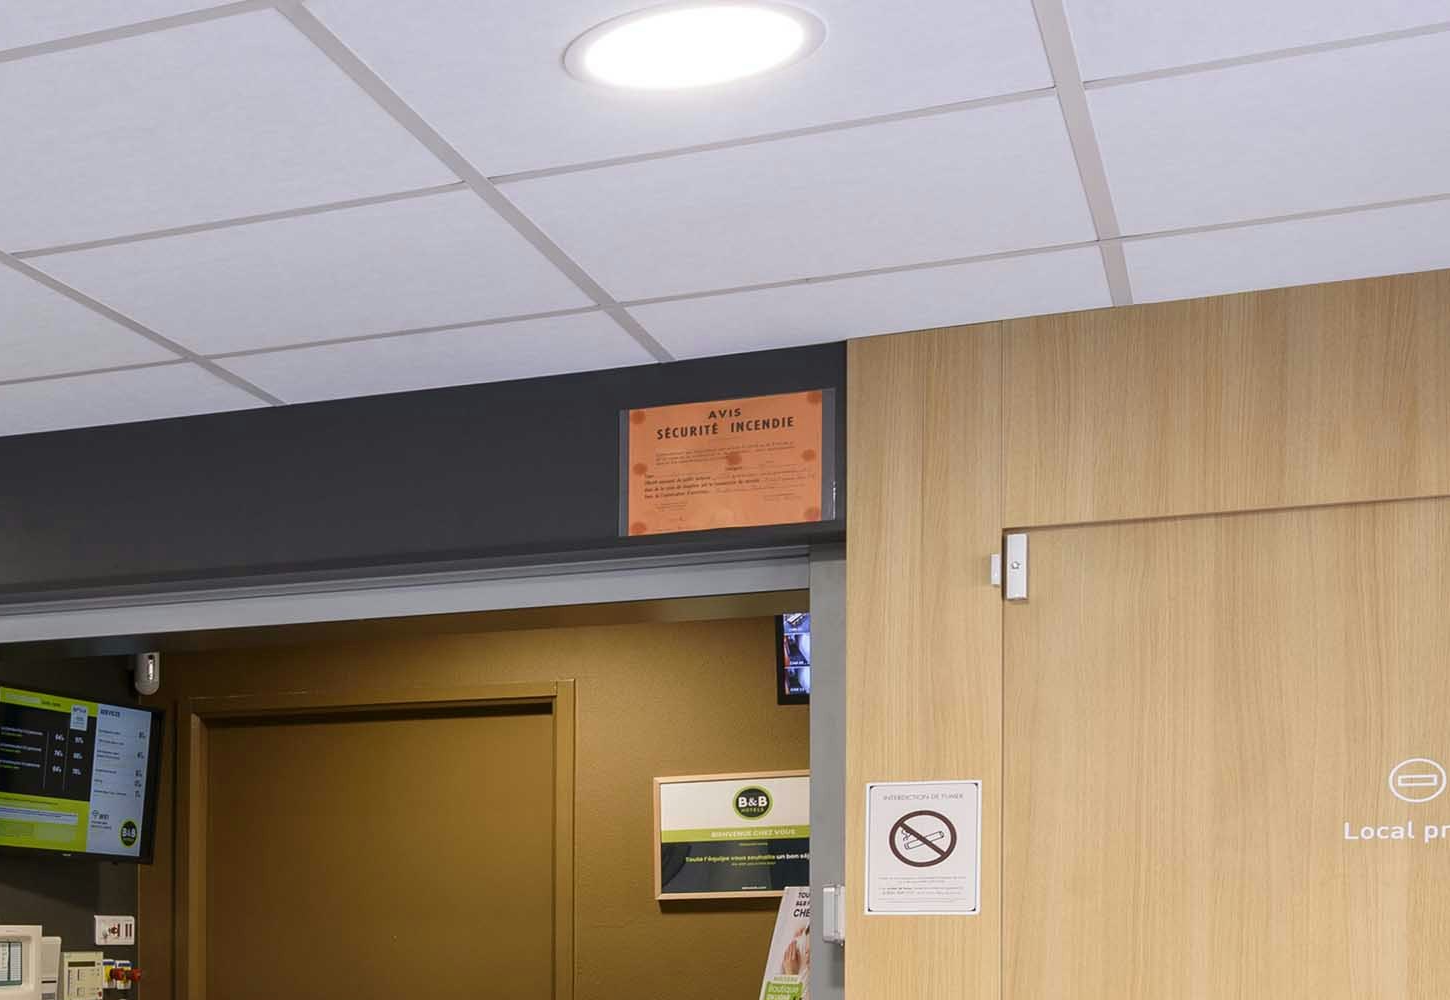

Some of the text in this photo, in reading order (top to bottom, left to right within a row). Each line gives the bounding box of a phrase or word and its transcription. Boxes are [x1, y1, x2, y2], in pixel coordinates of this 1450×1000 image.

[708, 408, 742, 420] AVIS
[656, 416, 795, 440] SÉCURITÉ INCENDIE
[738, 795, 769, 809] B&B
[1344, 820, 1415, 840] Local
